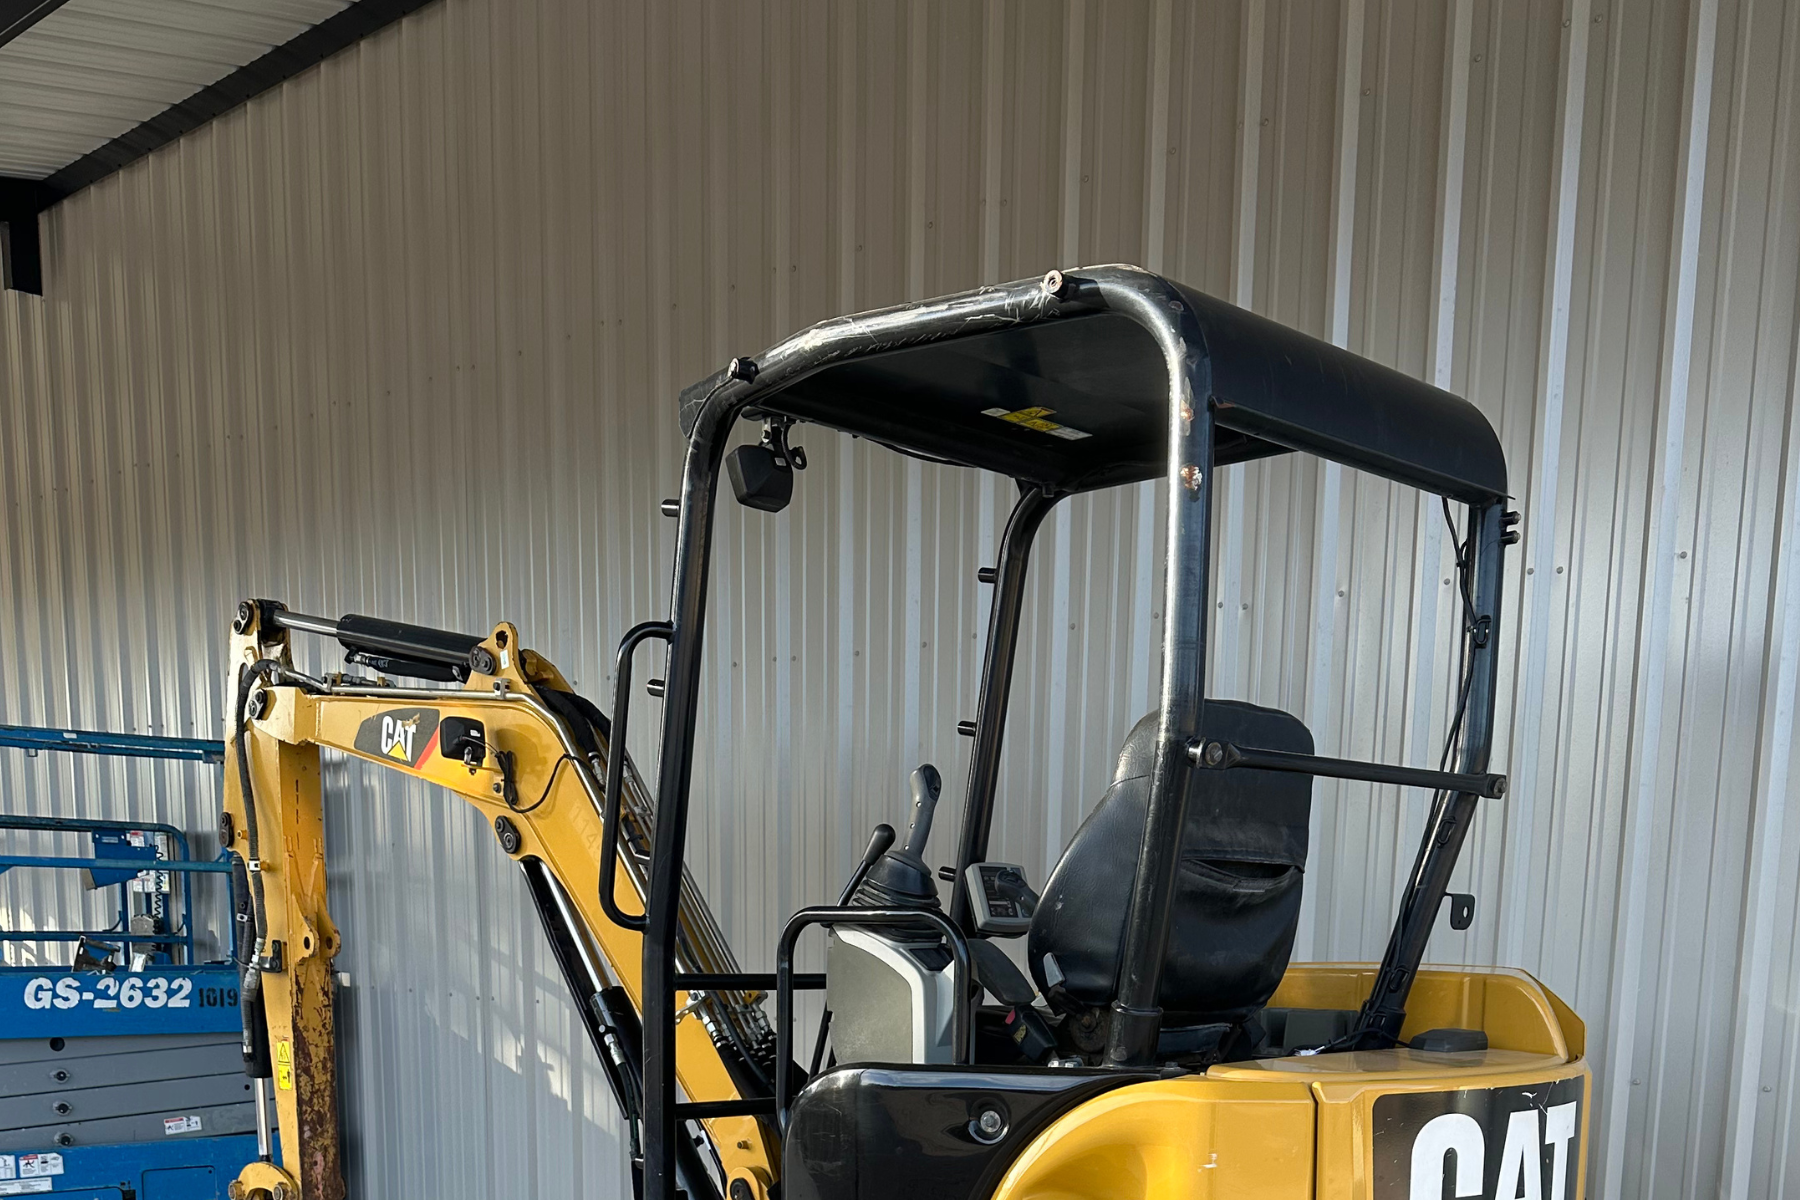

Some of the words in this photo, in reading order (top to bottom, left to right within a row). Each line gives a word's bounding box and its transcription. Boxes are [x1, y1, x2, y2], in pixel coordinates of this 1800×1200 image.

[381, 715, 416, 762] CAT
[24, 977, 193, 1009] GS-2632
[198, 987, 238, 1007] 1019
